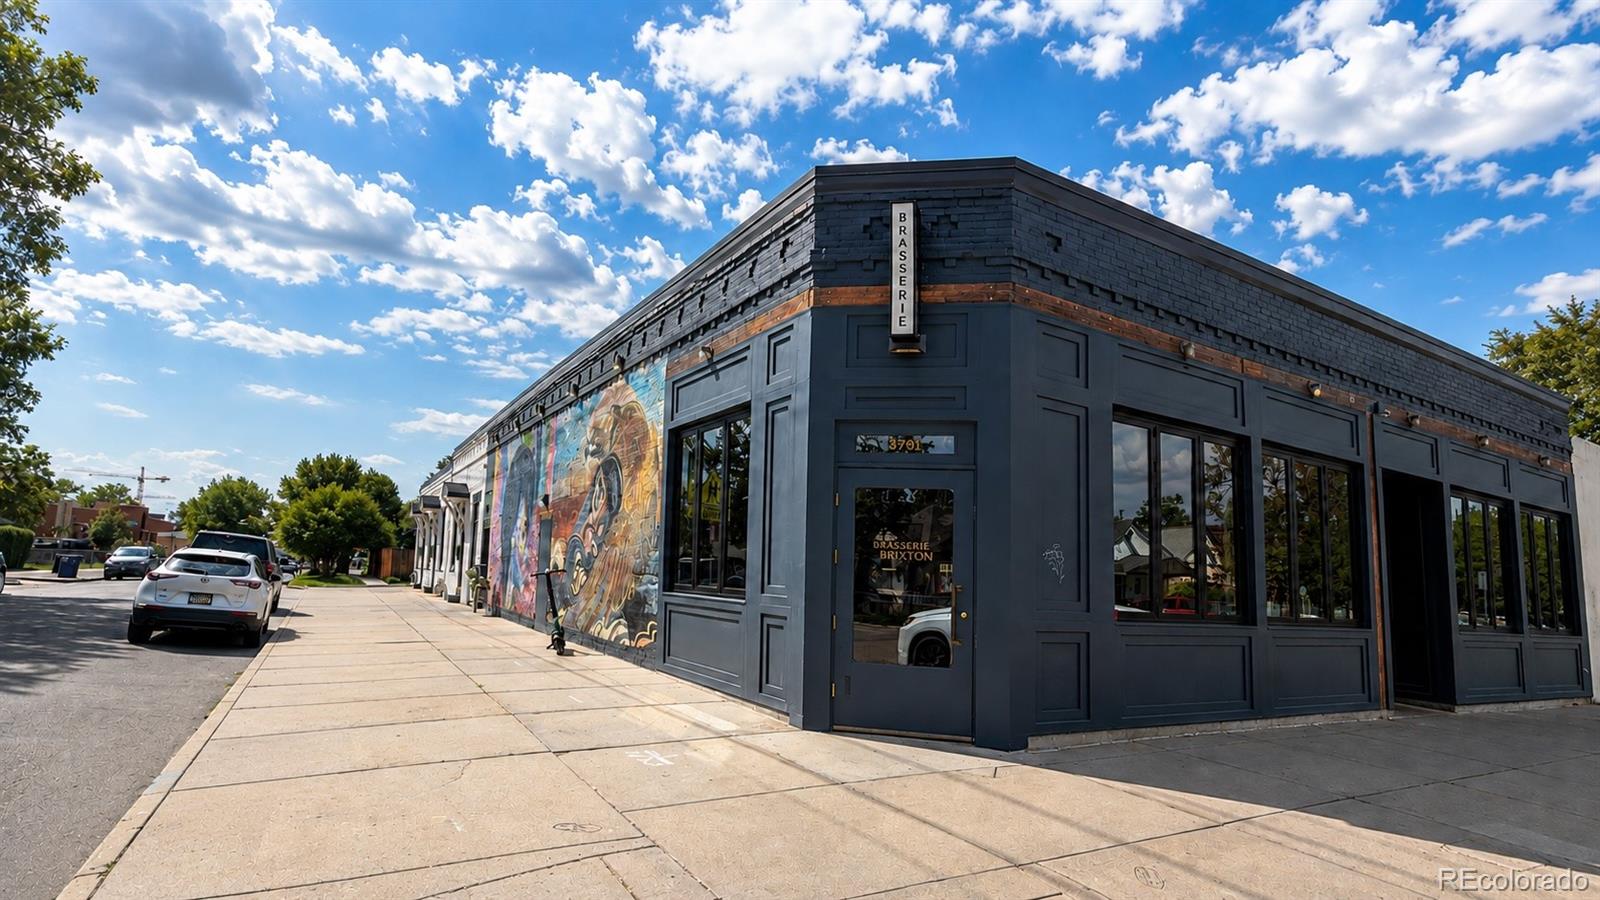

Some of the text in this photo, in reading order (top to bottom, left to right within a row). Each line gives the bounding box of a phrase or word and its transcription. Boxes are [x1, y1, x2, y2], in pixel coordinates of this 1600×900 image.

[898, 212, 907, 327] BRASSERIE
[889, 439, 922, 451] 3701
[880, 550, 933, 561] BRIXTON
